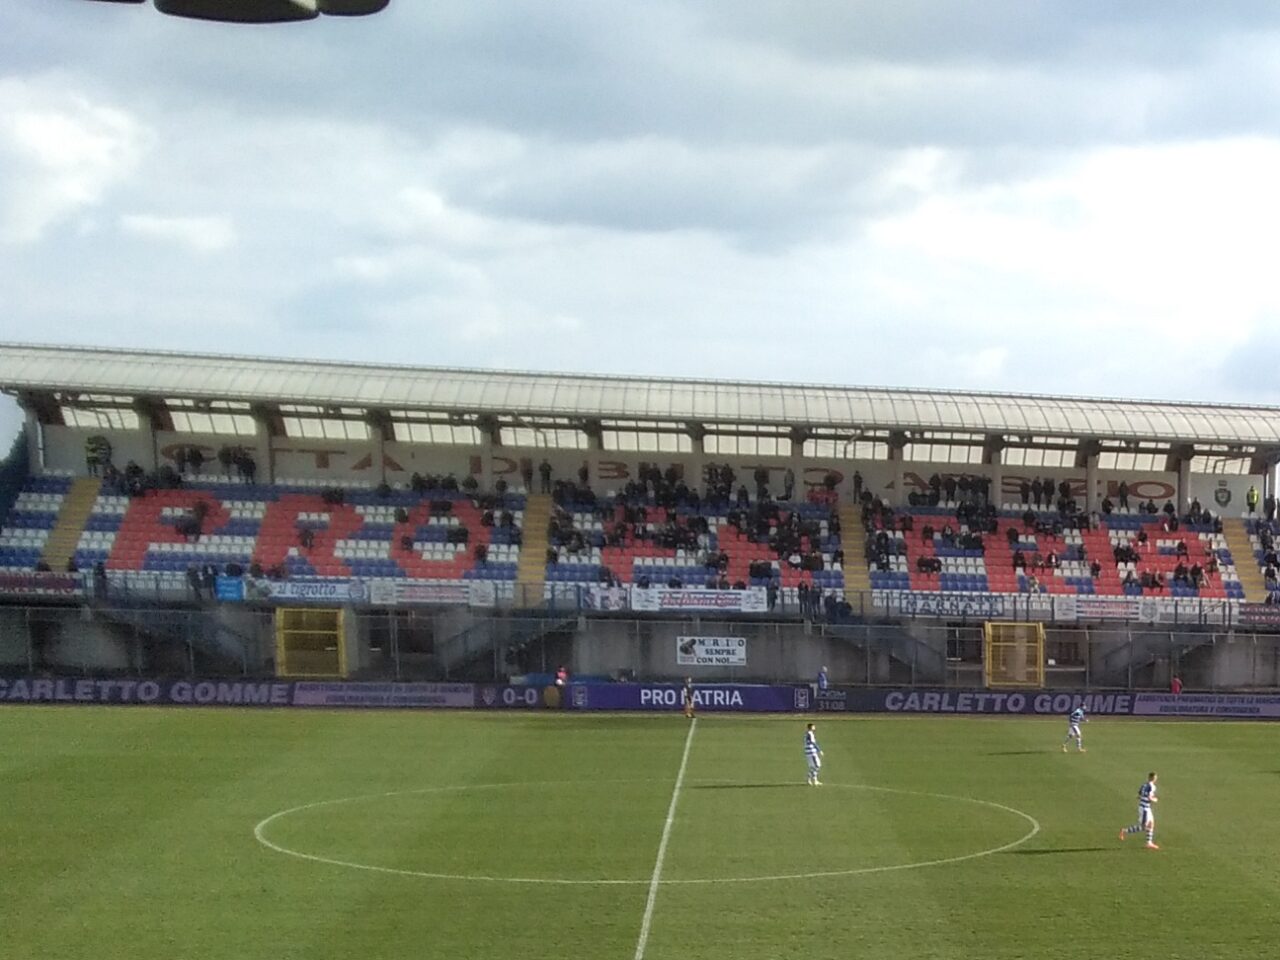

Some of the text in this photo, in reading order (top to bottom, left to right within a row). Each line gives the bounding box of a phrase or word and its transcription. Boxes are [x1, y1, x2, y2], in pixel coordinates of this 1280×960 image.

[106, 488, 492, 580] PRO
[291, 582, 336, 597] tigrotto
[705, 648, 737, 656] SEMPRE
[170, 681, 290, 704] GOMME
[503, 688, 538, 705] 0-0
[640, 689, 676, 706] PRO
[885, 691, 1130, 713] CARLETTO GOMME
